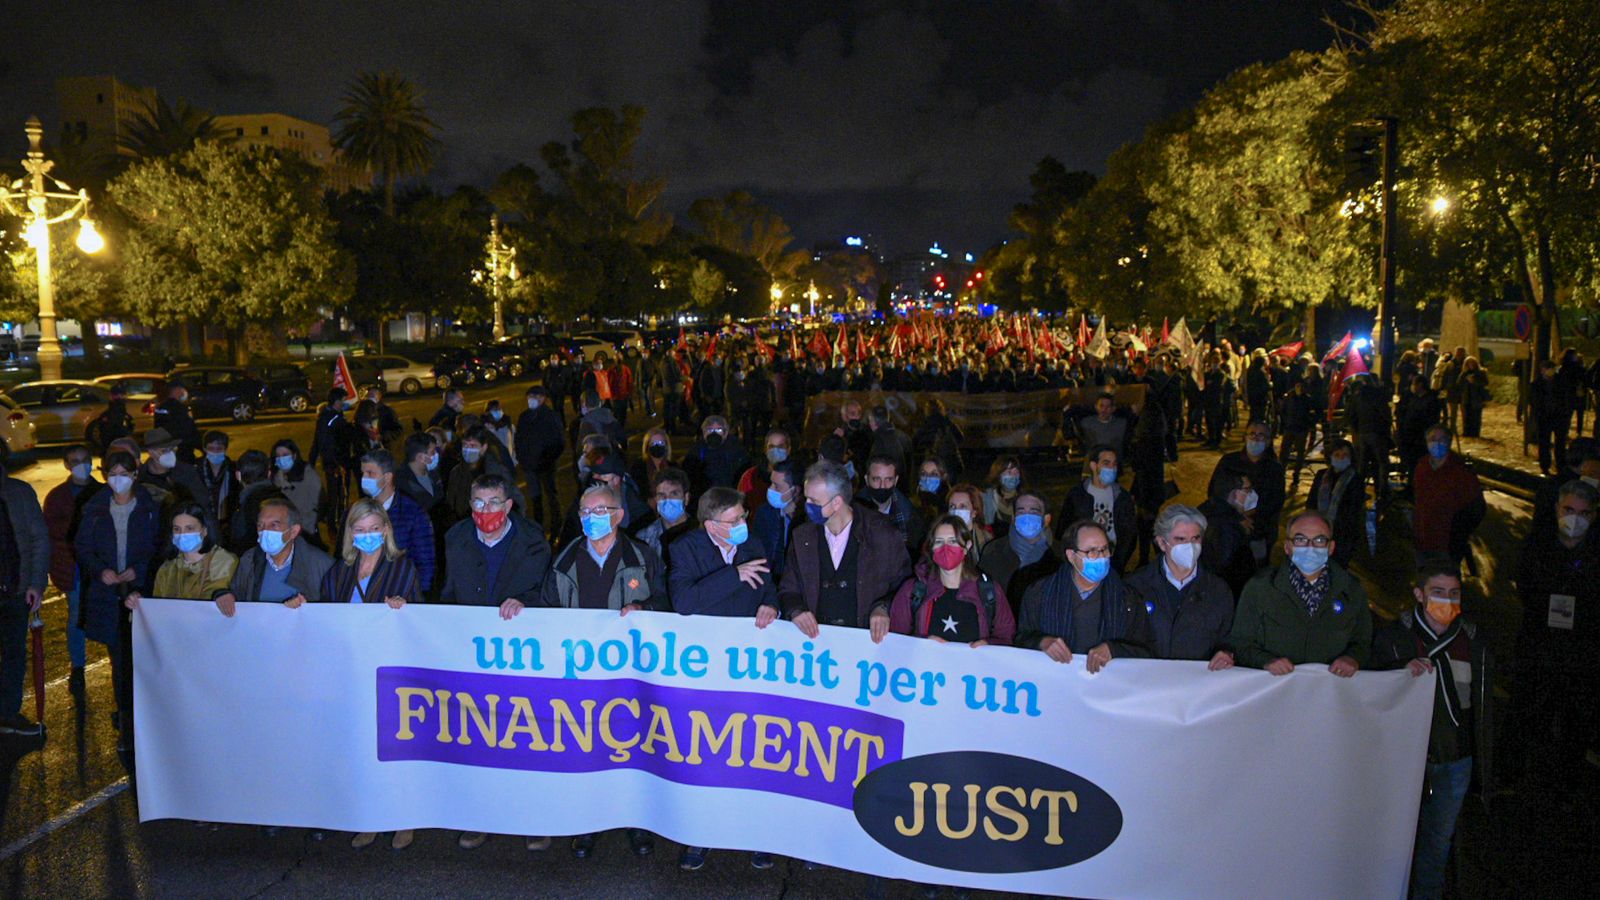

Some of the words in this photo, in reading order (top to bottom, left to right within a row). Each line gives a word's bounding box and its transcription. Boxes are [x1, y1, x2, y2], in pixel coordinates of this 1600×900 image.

[471, 635, 545, 671] un
[560, 627, 711, 680] poble
[724, 640, 841, 690] unit
[854, 659, 947, 708] per
[961, 673, 1042, 718] un
[395, 686, 886, 788] FINANÇAMENT
[894, 781, 1079, 846] JUST
